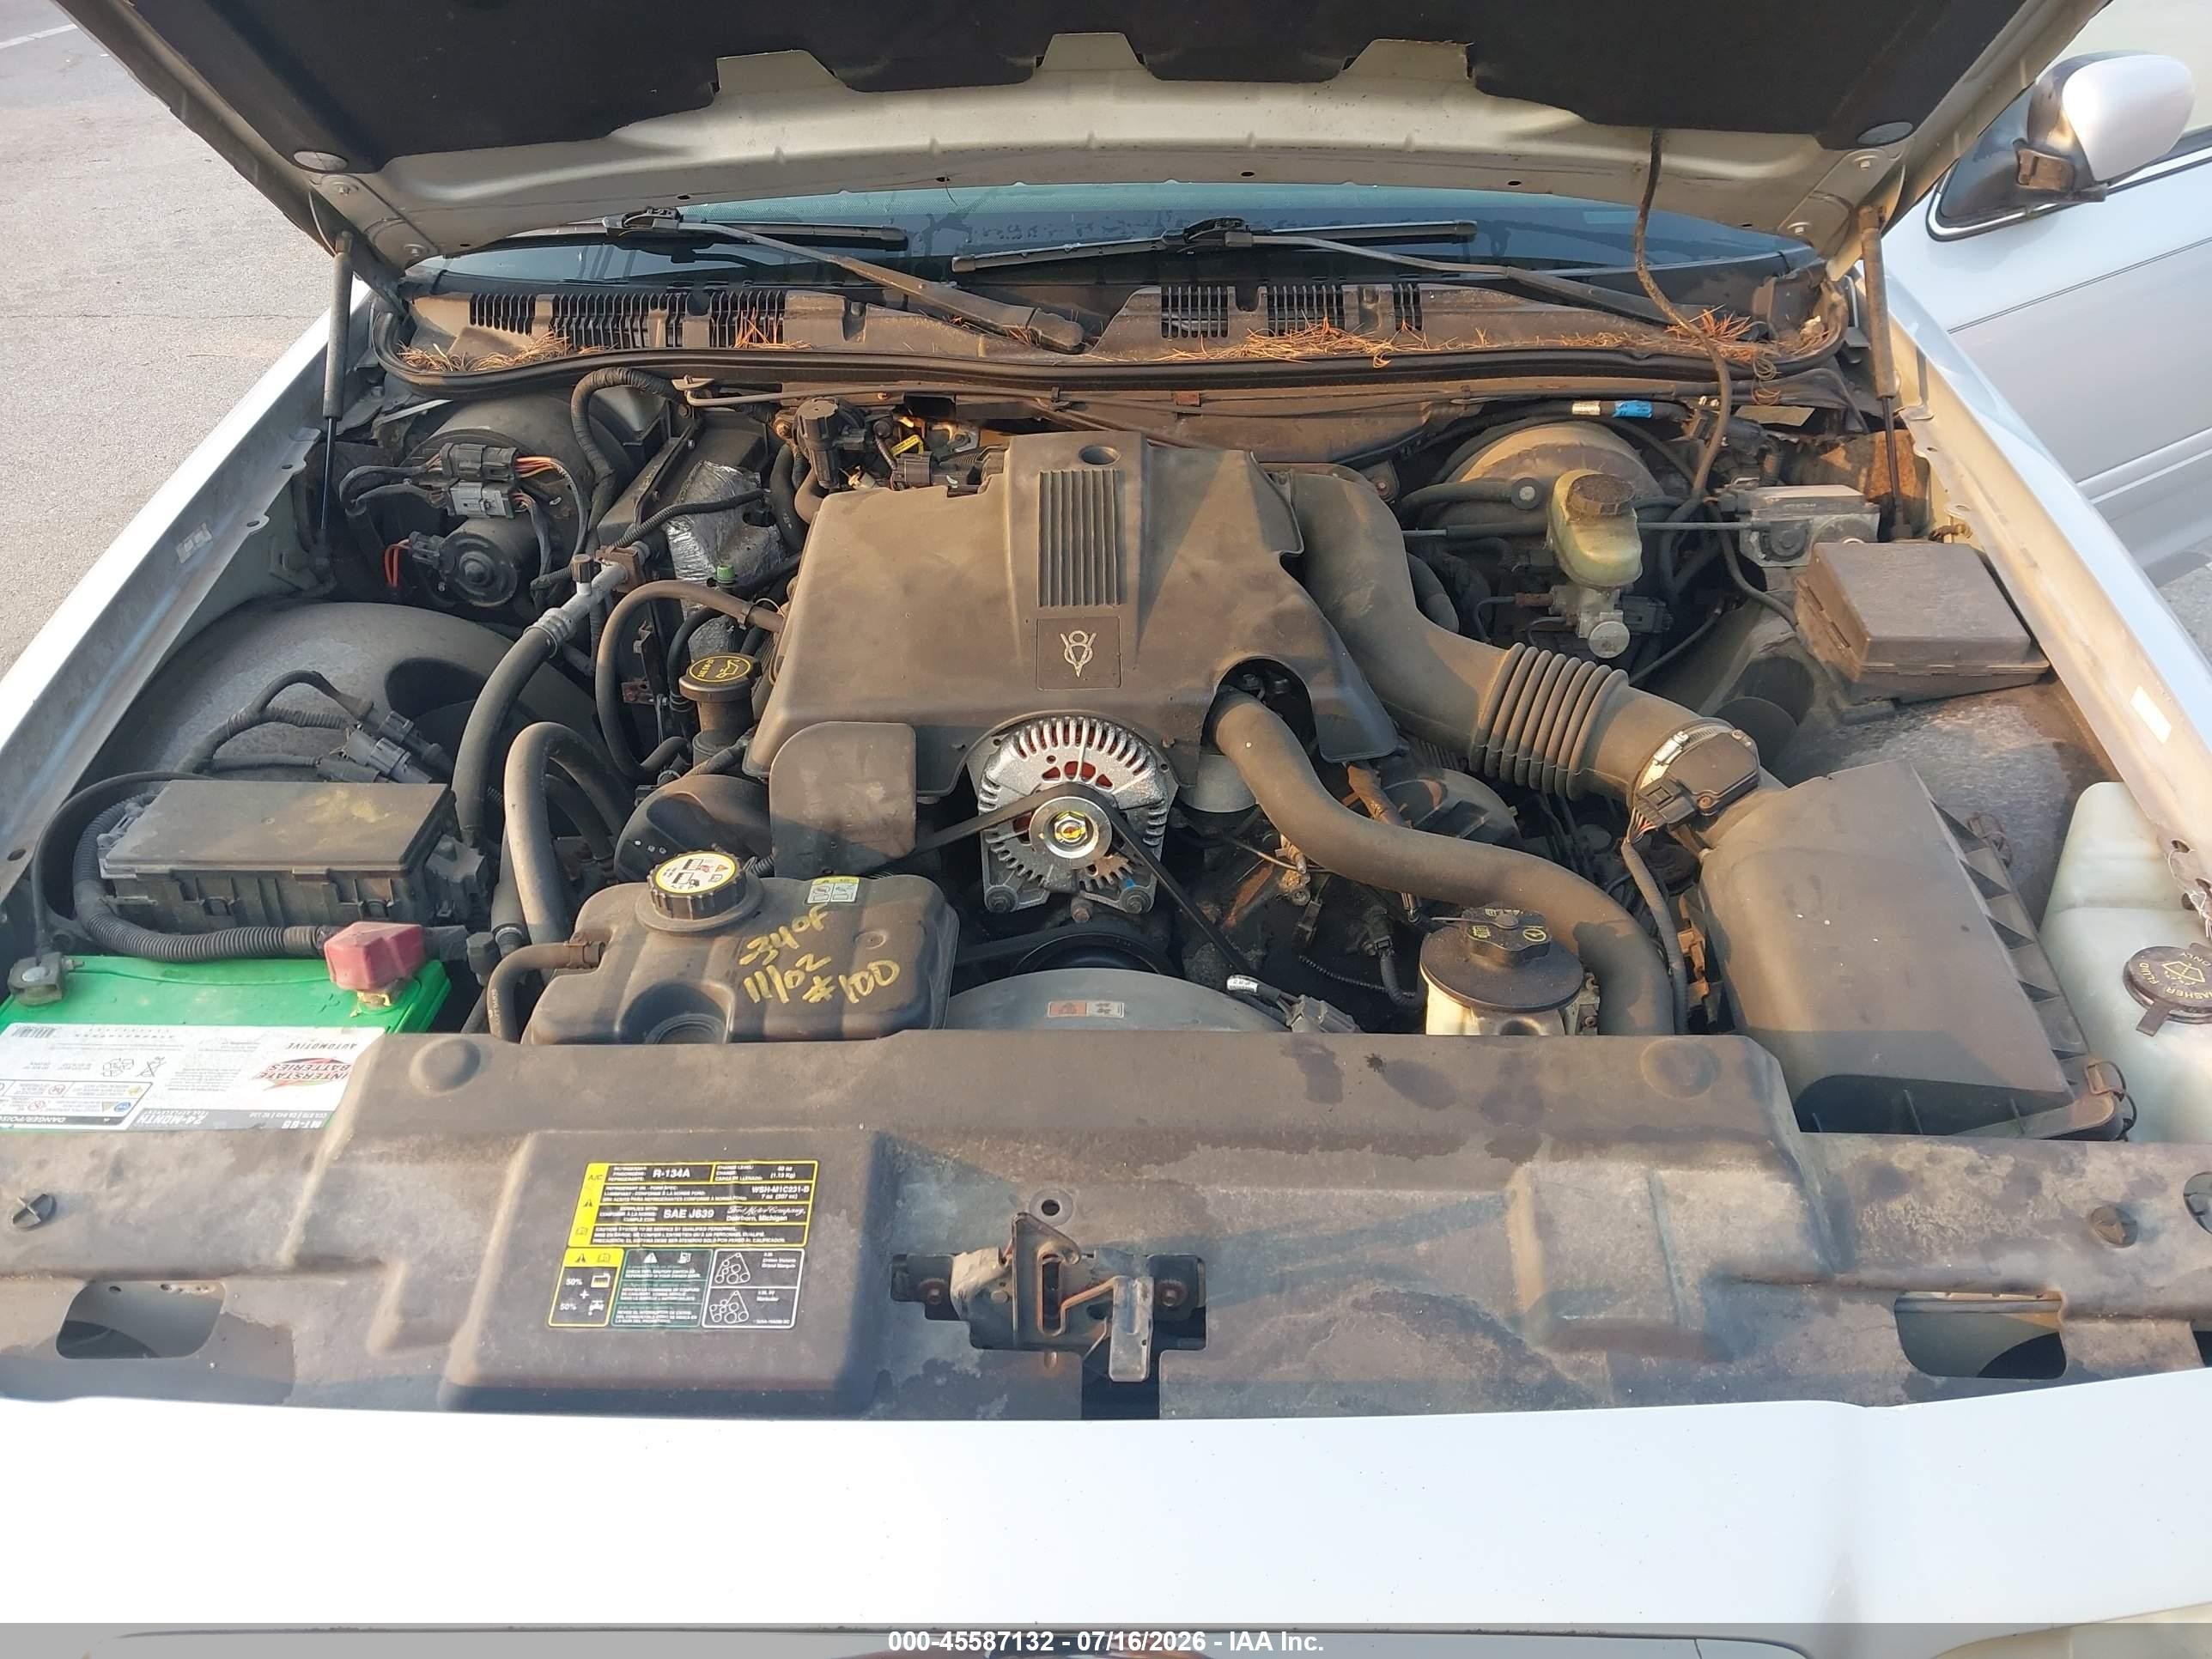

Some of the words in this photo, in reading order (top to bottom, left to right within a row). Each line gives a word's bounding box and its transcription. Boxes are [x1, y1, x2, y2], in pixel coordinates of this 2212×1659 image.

[2179, 951, 2212, 966] ONLY
[2139, 963, 2160, 984] FLUID
[285, 1042, 358, 1050] AUTOMOTIVE
[258, 1071, 349, 1080] INTERSTATE
[653, 1168, 691, 1178] R-134A
[663, 1209, 687, 1218] SAE
[689, 1208, 715, 1218] J639
[565, 1278, 583, 1286] 50%
[559, 1303, 577, 1311] 50%
